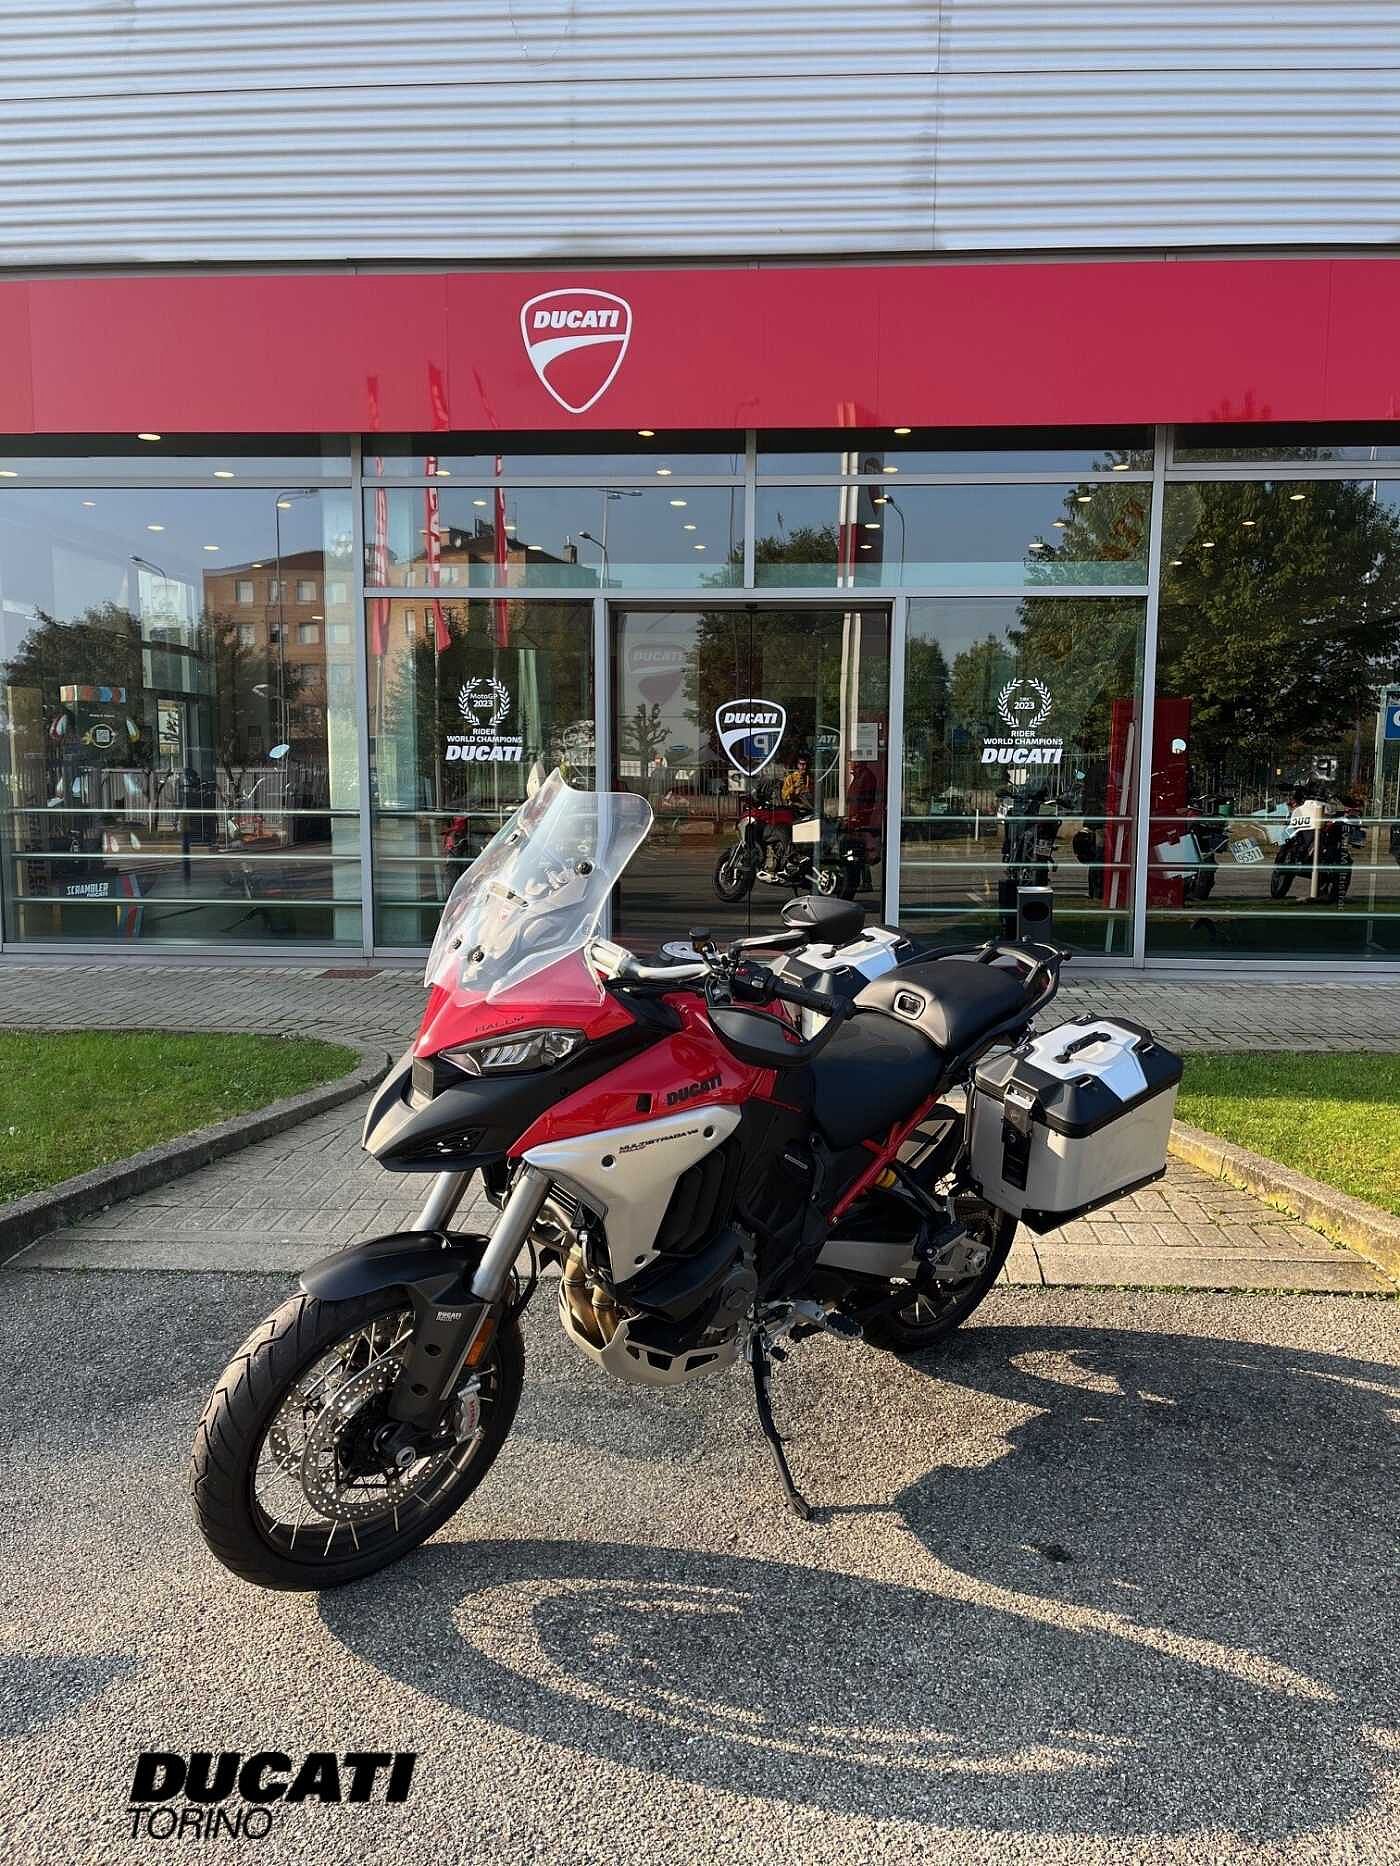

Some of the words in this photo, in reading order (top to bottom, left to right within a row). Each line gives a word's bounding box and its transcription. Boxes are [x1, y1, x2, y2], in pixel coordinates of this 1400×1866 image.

[533, 310, 620, 329] DUCATI
[473, 700, 494, 708] 2023
[1013, 702, 1035, 710] 2023
[724, 713, 777, 724] DUCATI
[472, 728, 497, 736] RIDER
[1010, 730, 1036, 738] RIDER
[446, 735, 476, 743] WORLD
[476, 735, 524, 744] CHAMPIONS
[1014, 737, 1064, 746] CHAMPIONS
[445, 745, 524, 761] DUCATI
[981, 748, 1064, 764] DUCATI
[66, 882, 110, 896] SCRAMBLER
[666, 1075, 722, 1106] DUCATI
